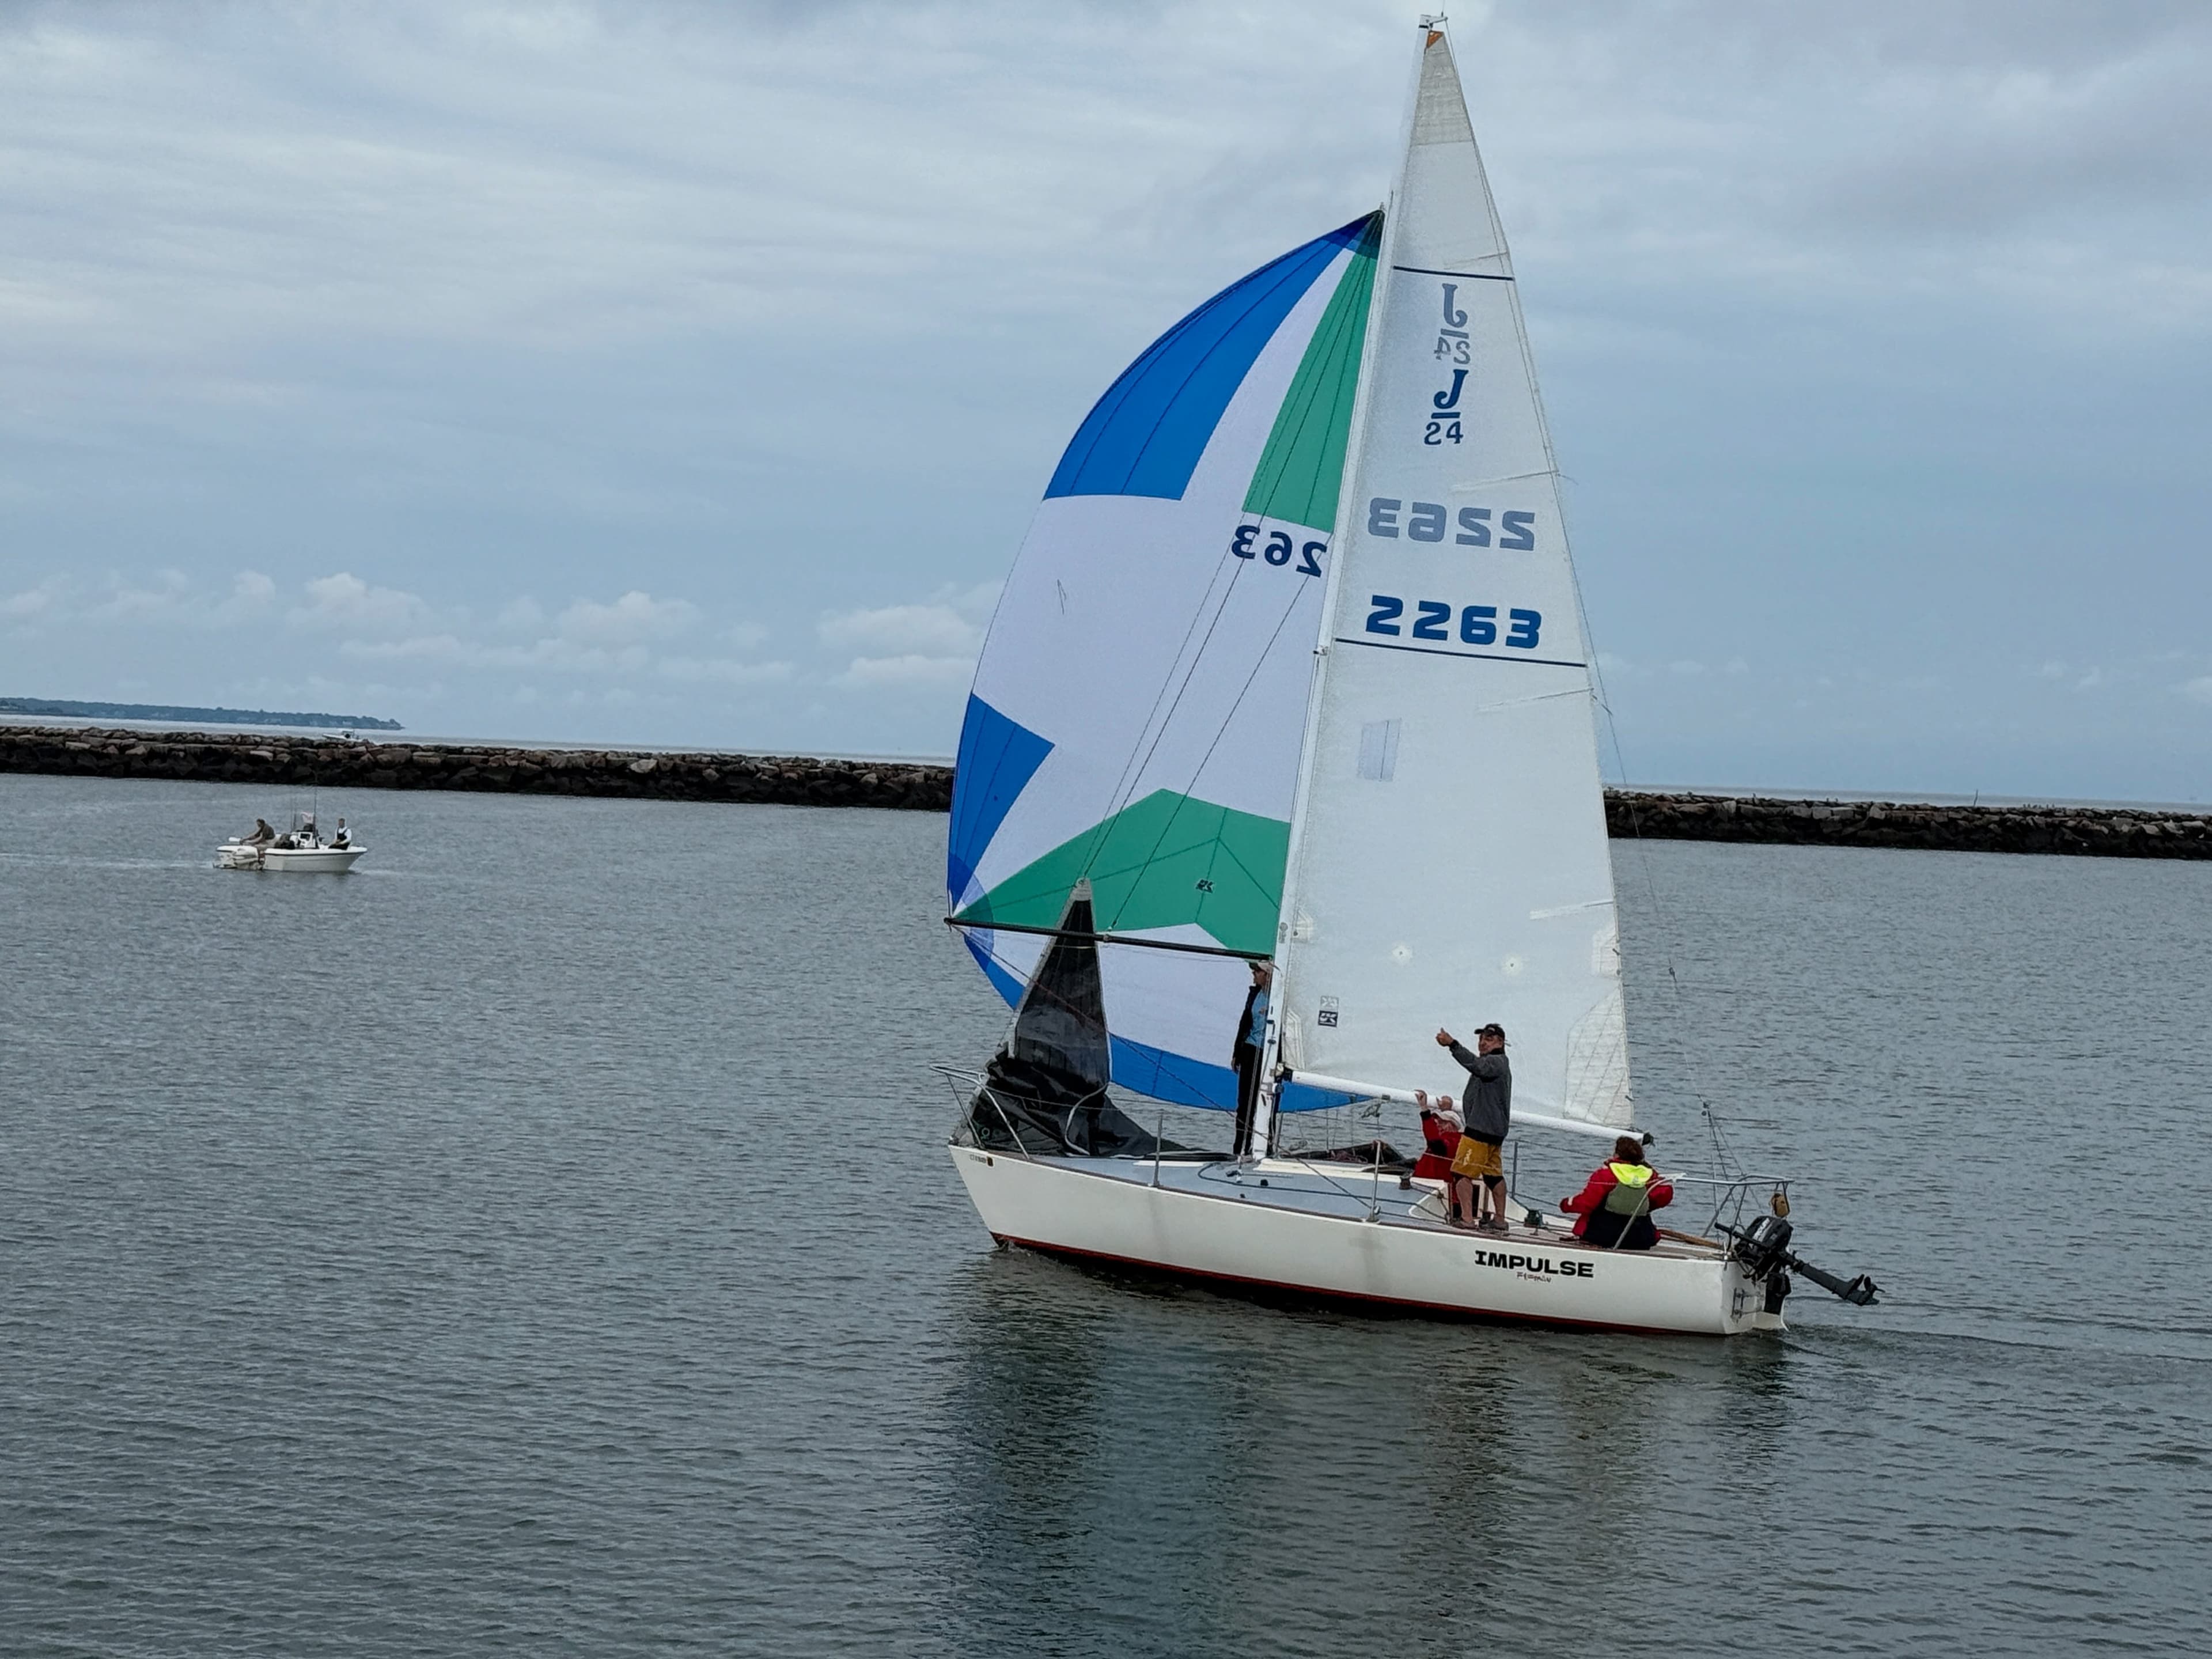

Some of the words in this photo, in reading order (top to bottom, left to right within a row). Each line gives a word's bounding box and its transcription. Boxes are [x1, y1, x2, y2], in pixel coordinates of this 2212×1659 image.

[1433, 369, 1469, 409] J
[1424, 421, 1463, 445] 24
[1366, 594, 1542, 649] 2263
[1475, 1250, 1594, 1278] IMPULSE
